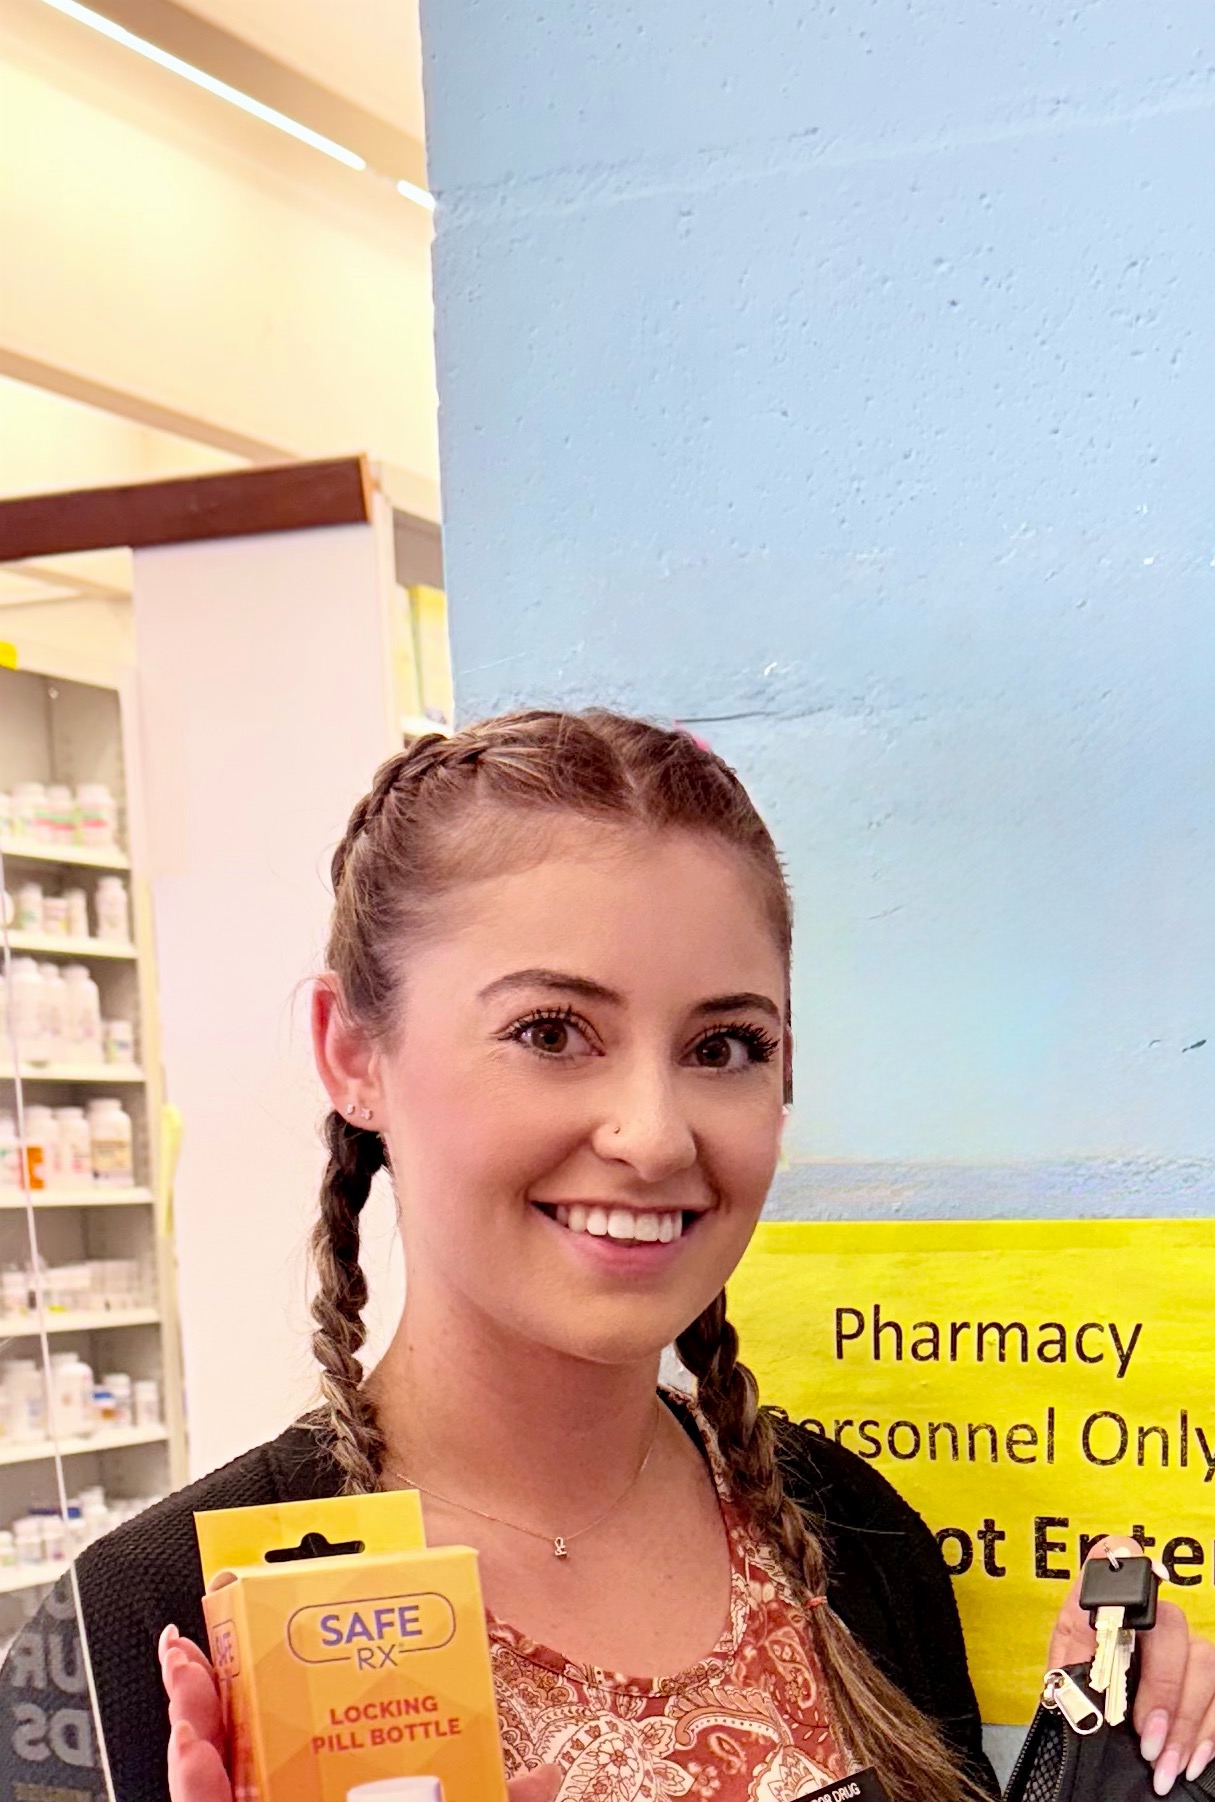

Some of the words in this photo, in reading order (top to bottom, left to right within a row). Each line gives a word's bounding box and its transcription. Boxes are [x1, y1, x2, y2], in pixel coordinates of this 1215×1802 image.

[834, 1304, 1143, 1379] Pharmacy
[935, 1518, 1007, 1579] ot
[320, 1605, 423, 1647] SAFE
[357, 1643, 398, 1671] RX
[329, 1695, 439, 1726] LOCKING
[311, 1731, 365, 1755] PILL
[370, 1718, 462, 1747] BOTTLE
[832, 1782, 861, 1802] DRUG
